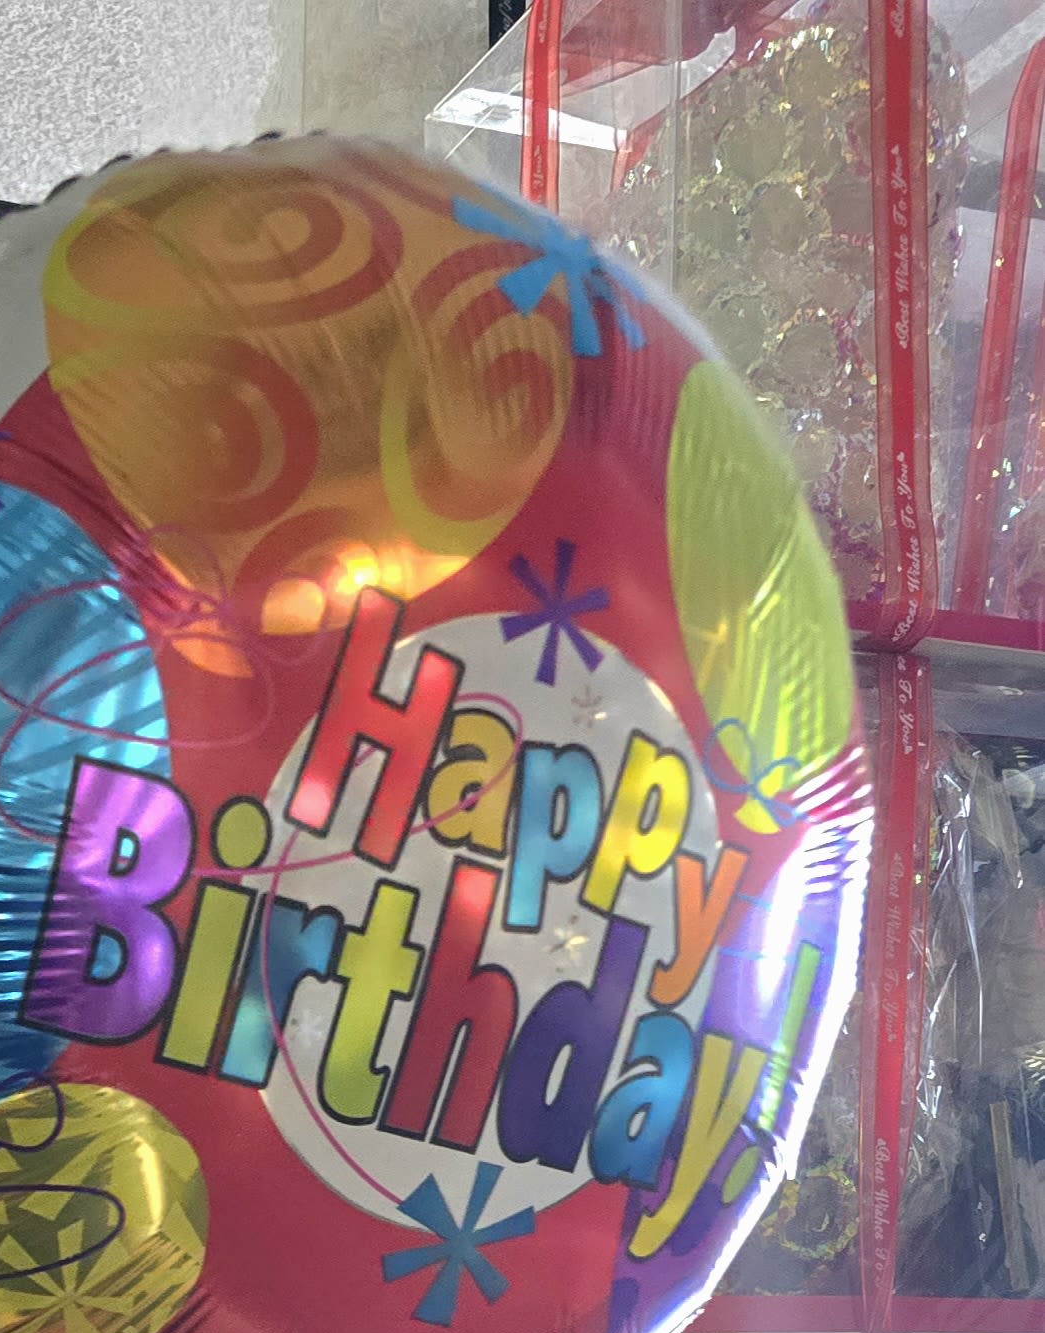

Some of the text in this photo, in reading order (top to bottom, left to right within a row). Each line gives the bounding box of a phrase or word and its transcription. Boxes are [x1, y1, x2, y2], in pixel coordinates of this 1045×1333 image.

[890, 154, 908, 196] You
[891, 200, 908, 230] To
[895, 234, 911, 293] Wishes
[897, 464, 915, 501] You
[901, 506, 917, 534] To
[906, 535, 922, 594] Wishes
[897, 679, 914, 710] To
[898, 706, 916, 747] You
[287, 585, 749, 1007] Happy
[885, 901, 904, 965] Wishes
[883, 967, 901, 993] To
[16, 753, 821, 1262] Birthday!
[882, 996, 901, 1032] You
[873, 1145, 891, 1182] Best
[872, 1185, 891, 1244] Wishes
[872, 1247, 890, 1276] To
